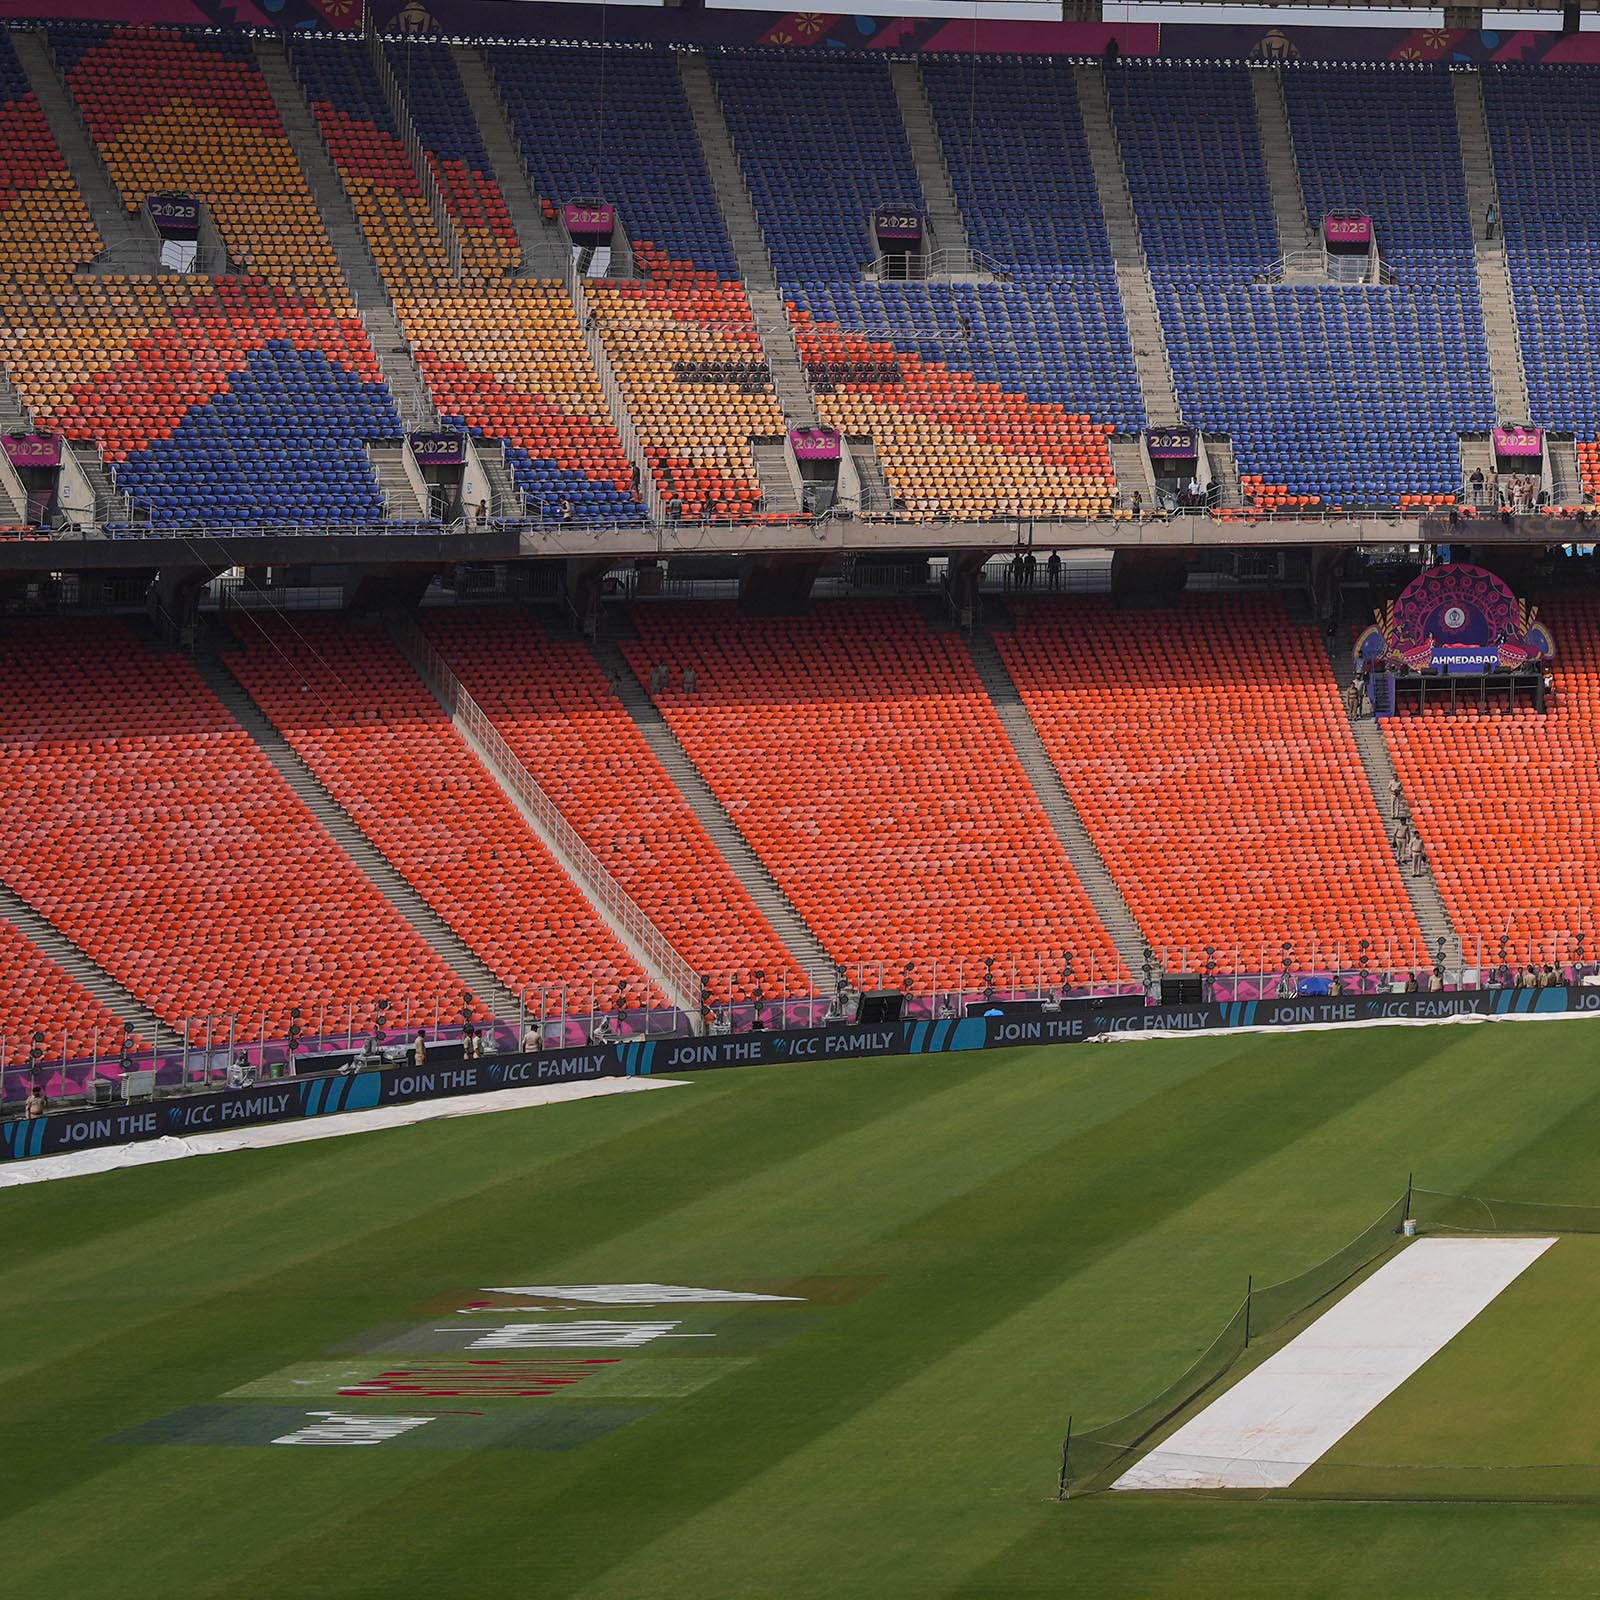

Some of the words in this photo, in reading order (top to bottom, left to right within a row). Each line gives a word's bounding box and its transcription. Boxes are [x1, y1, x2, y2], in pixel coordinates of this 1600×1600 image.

[1432, 654, 1498, 666] AHMEDABAD
[1269, 1007, 1314, 1023] JOIN
[1320, 1004, 1355, 1020] THE
[1382, 1002, 1409, 1017] ICC
[1416, 999, 1480, 1015] FAMILY
[994, 1024, 1040, 1041] JOIN
[1046, 1020, 1082, 1037] THE
[1109, 1016, 1136, 1032] ICC
[1143, 1013, 1208, 1030] FAMILY
[668, 1045, 717, 1064] JOIN
[723, 1042, 761, 1059] THE
[789, 1038, 818, 1054] ICC
[825, 1032, 894, 1052] FAMILY
[389, 1074, 435, 1096] JOIN
[441, 1069, 476, 1088] THE
[503, 1062, 531, 1081] ICC
[538, 1055, 605, 1077] FAMILY
[59, 1121, 111, 1143] JOIN
[117, 1114, 156, 1134] THE
[184, 1105, 215, 1125] ICC
[221, 1095, 289, 1119] FAMILY
